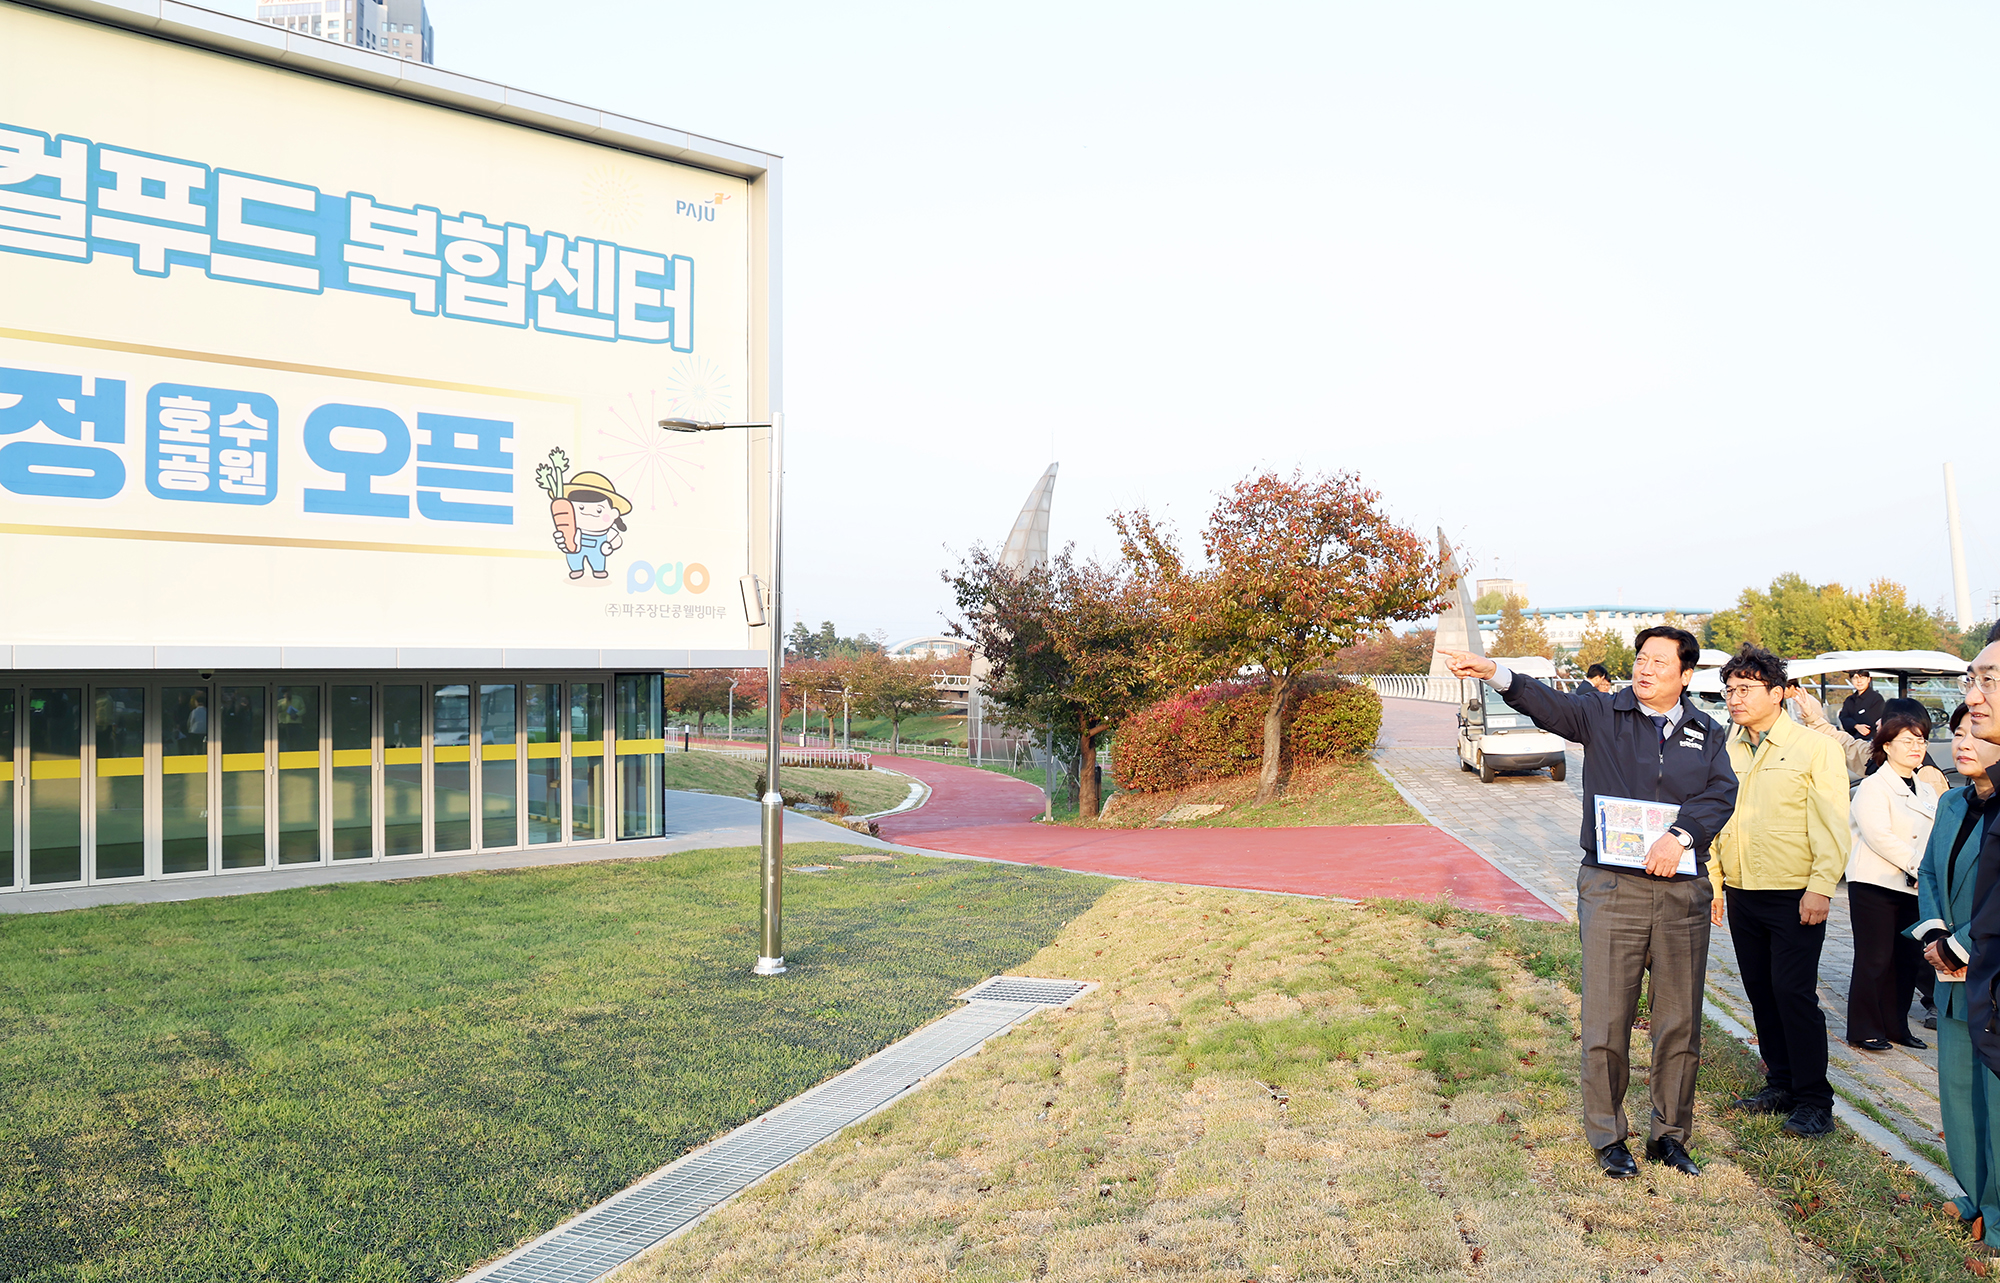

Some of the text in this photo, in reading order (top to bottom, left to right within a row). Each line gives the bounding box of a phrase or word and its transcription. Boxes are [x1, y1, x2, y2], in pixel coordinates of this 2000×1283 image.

[676, 199, 715, 222] PAJU
[0, 123, 694, 353] 컬푸드 복합센터
[0, 366, 514, 525] 정 오픈
[158, 394, 269, 448] 호수
[157, 443, 268, 496] 공원
[604, 602, 727, 620] (주)파주장단콩웰빙마루
